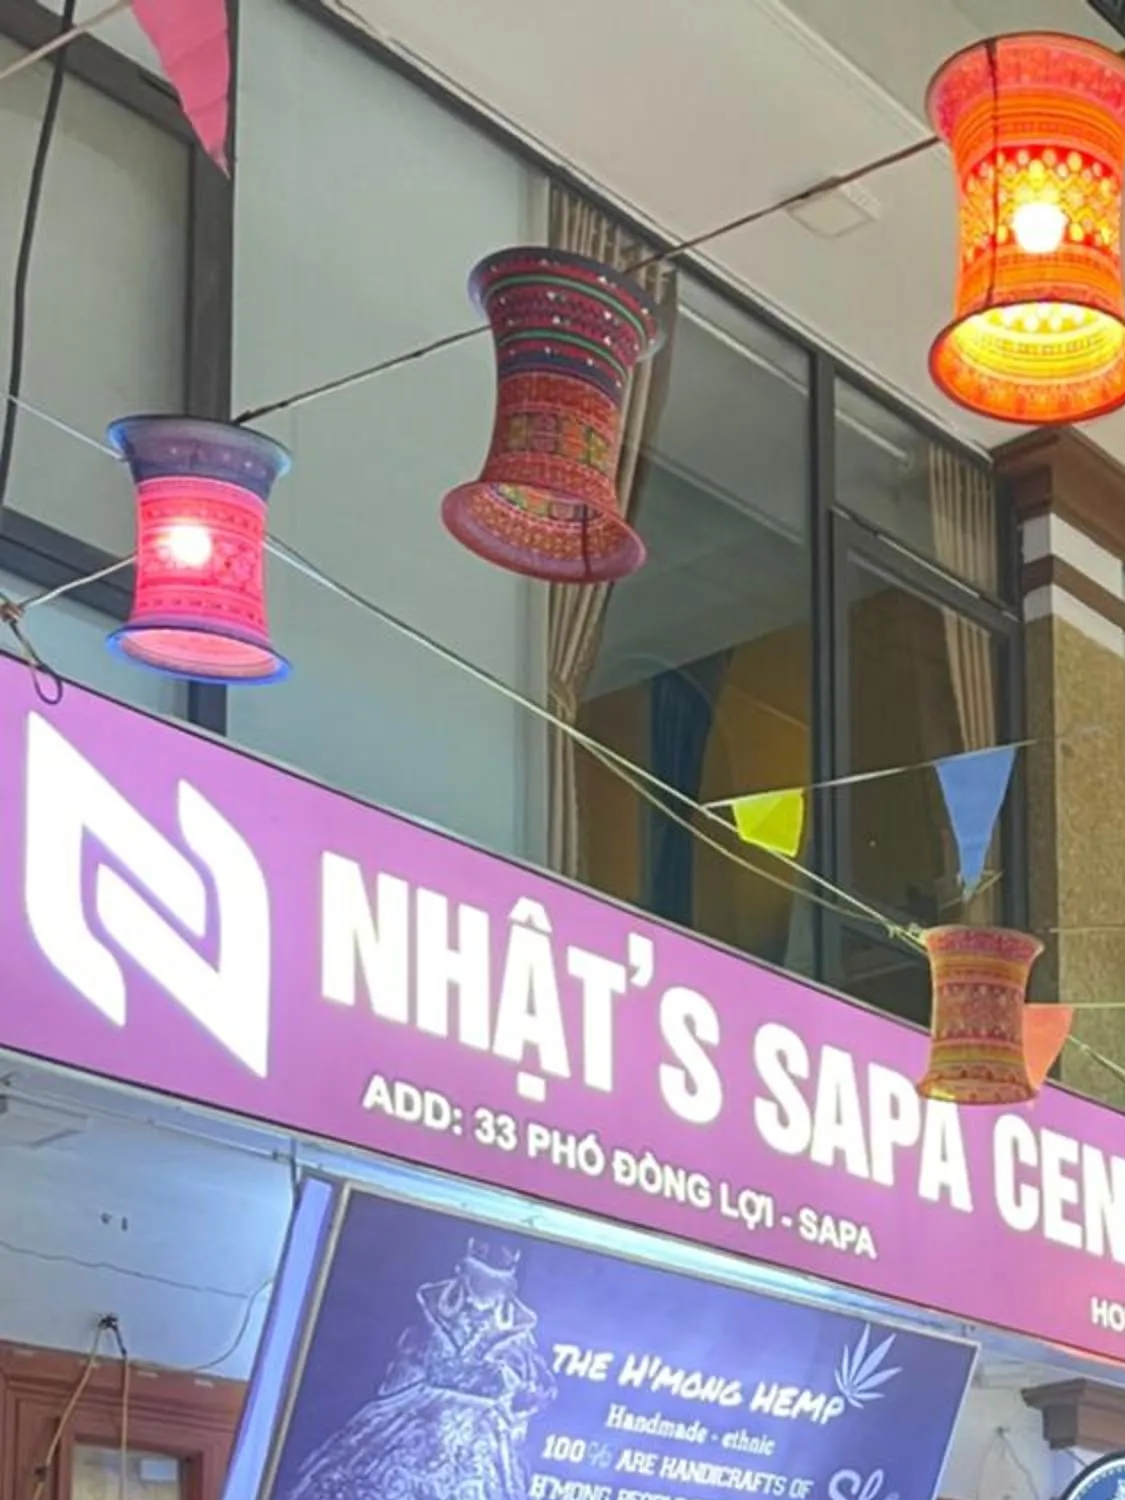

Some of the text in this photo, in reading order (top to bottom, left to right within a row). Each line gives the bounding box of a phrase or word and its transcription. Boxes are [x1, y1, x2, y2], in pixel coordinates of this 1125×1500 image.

[754, 1021, 973, 1214] SAPA
[362, 1074, 463, 1136] ADD:
[474, 1107, 518, 1150] 33
[781, 1214, 793, 1228] -
[798, 1207, 878, 1260] SAPA
[552, 1343, 614, 1382] THE
[749, 1381, 846, 1425] HEMP
[605, 1403, 706, 1444] Handmade
[721, 1428, 776, 1456] ethnic
[614, 1449, 656, 1476] ARE
[658, 1455, 787, 1497] HANDICRAFTS
[788, 1477, 815, 1500] OF
